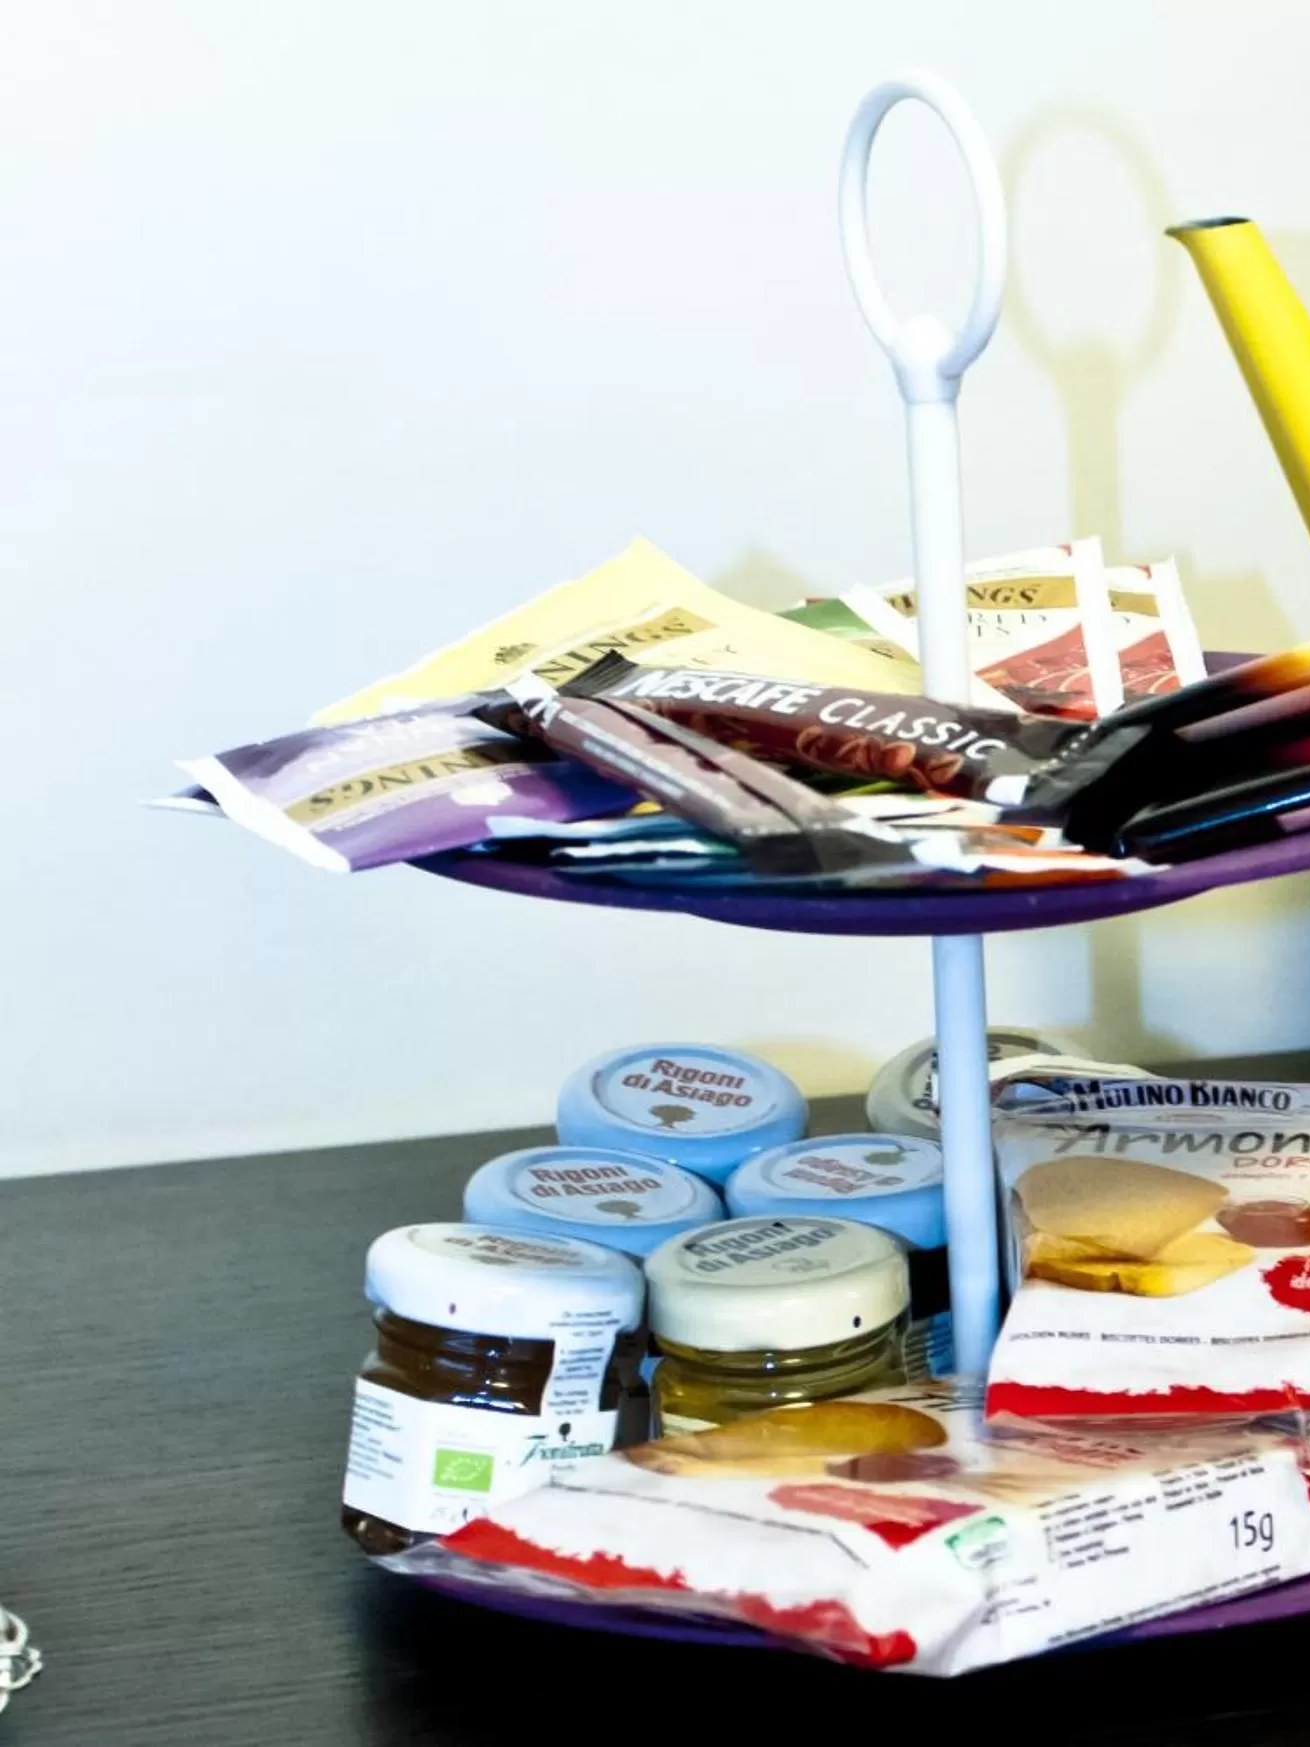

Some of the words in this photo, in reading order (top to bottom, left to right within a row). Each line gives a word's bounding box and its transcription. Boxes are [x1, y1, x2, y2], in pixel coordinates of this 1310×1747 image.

[531, 615, 695, 681] NINGS
[818, 697, 1007, 760] CLASSIC
[621, 1073, 651, 1090] di
[650, 1078, 753, 1107] Asiago
[650, 1058, 746, 1089] Rigoni
[1068, 1078, 1185, 1112] MULINO
[1190, 1079, 1292, 1111] BIANCO
[528, 1165, 629, 1183] Rigoni
[530, 1183, 562, 1198] di
[561, 1177, 663, 1197] Asiago
[695, 1257, 732, 1273] di
[726, 1226, 837, 1265] Asiago
[1229, 1510, 1274, 1552] 15g
